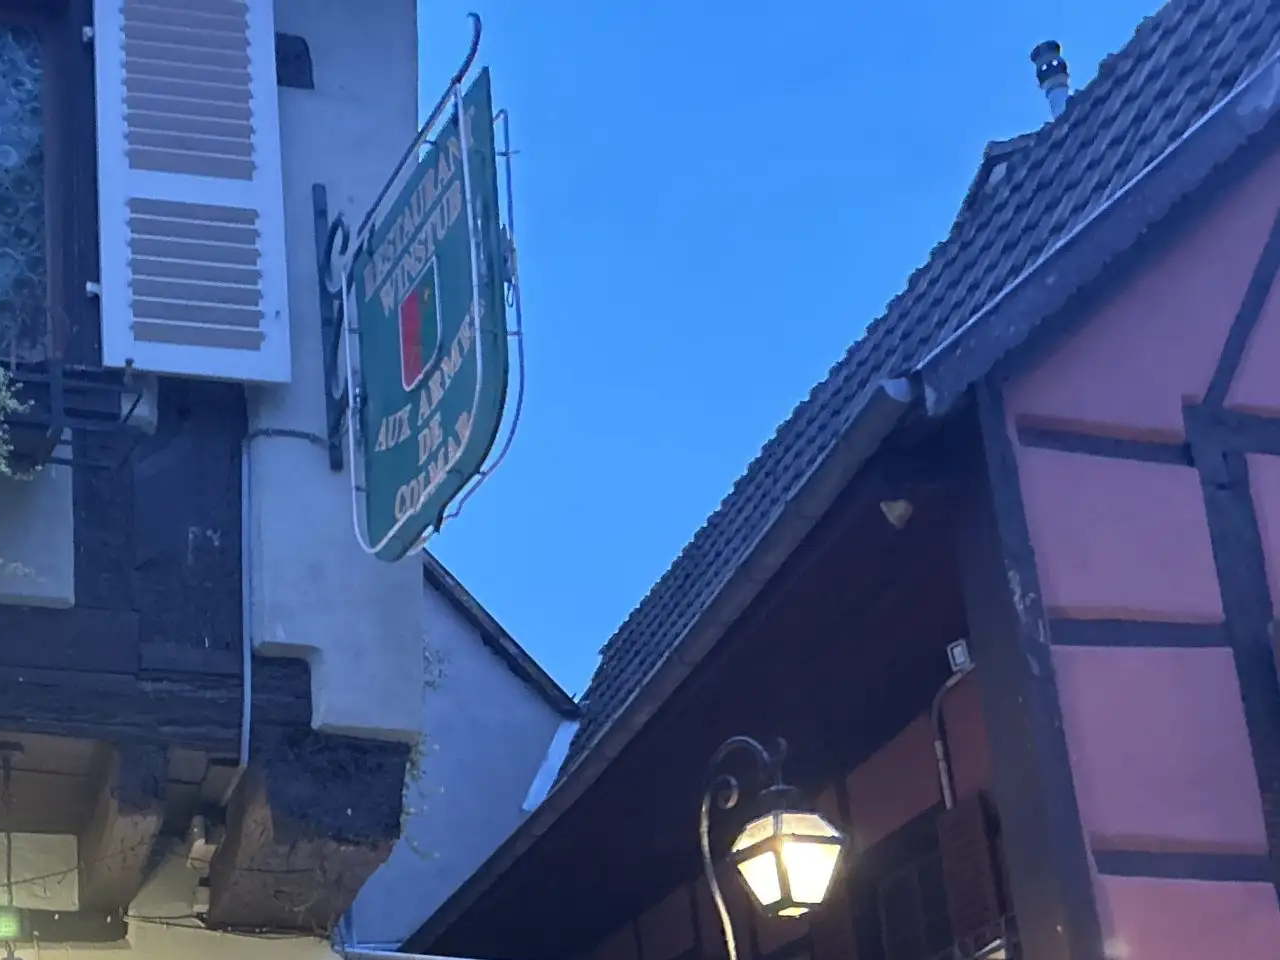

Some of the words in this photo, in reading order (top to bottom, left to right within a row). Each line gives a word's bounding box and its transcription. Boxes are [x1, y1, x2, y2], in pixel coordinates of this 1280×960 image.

[379, 179, 463, 318] WINSTUB
[374, 402, 413, 452] AUX
[417, 298, 486, 427] ARMES
[394, 411, 472, 521] COLMAR
[418, 411, 444, 466] DE
